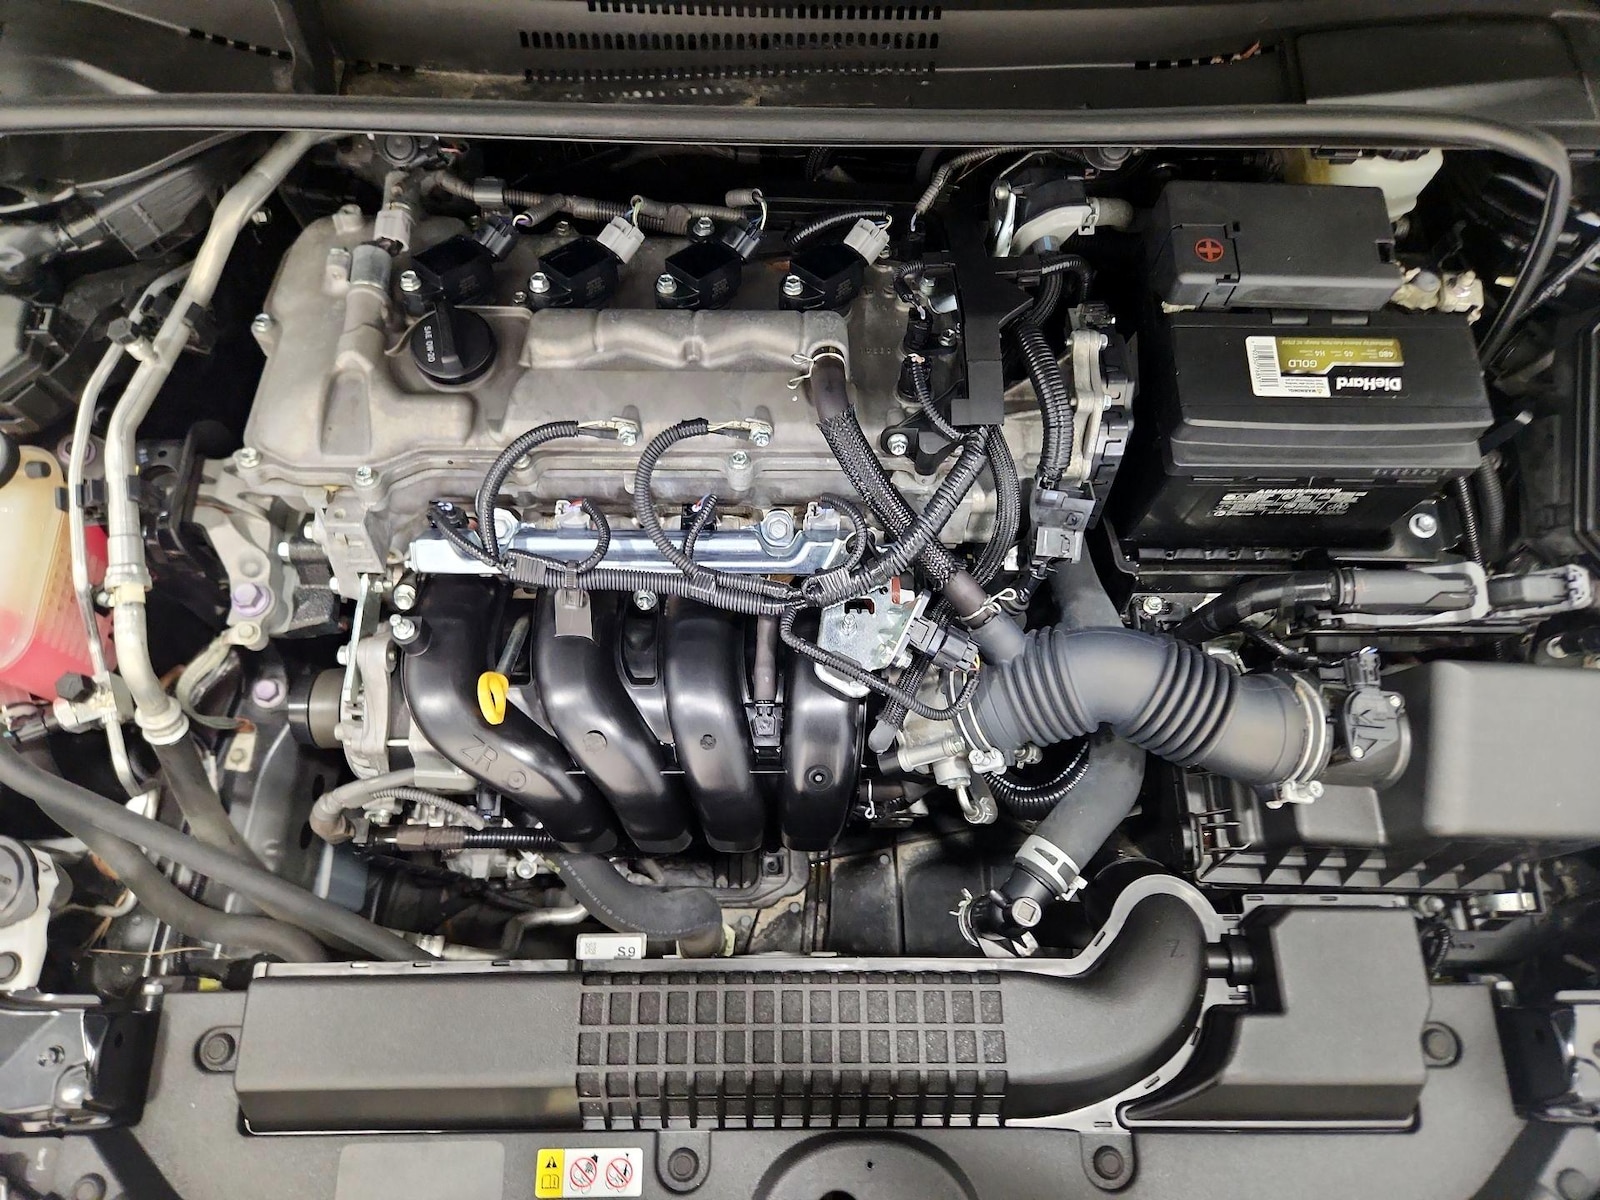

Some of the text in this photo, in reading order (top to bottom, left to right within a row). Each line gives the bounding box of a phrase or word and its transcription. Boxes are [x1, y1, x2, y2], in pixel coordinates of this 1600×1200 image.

[424, 325, 433, 339] SAE
[1288, 359, 1318, 368] GOLD
[1335, 376, 1402, 391] DieHard
